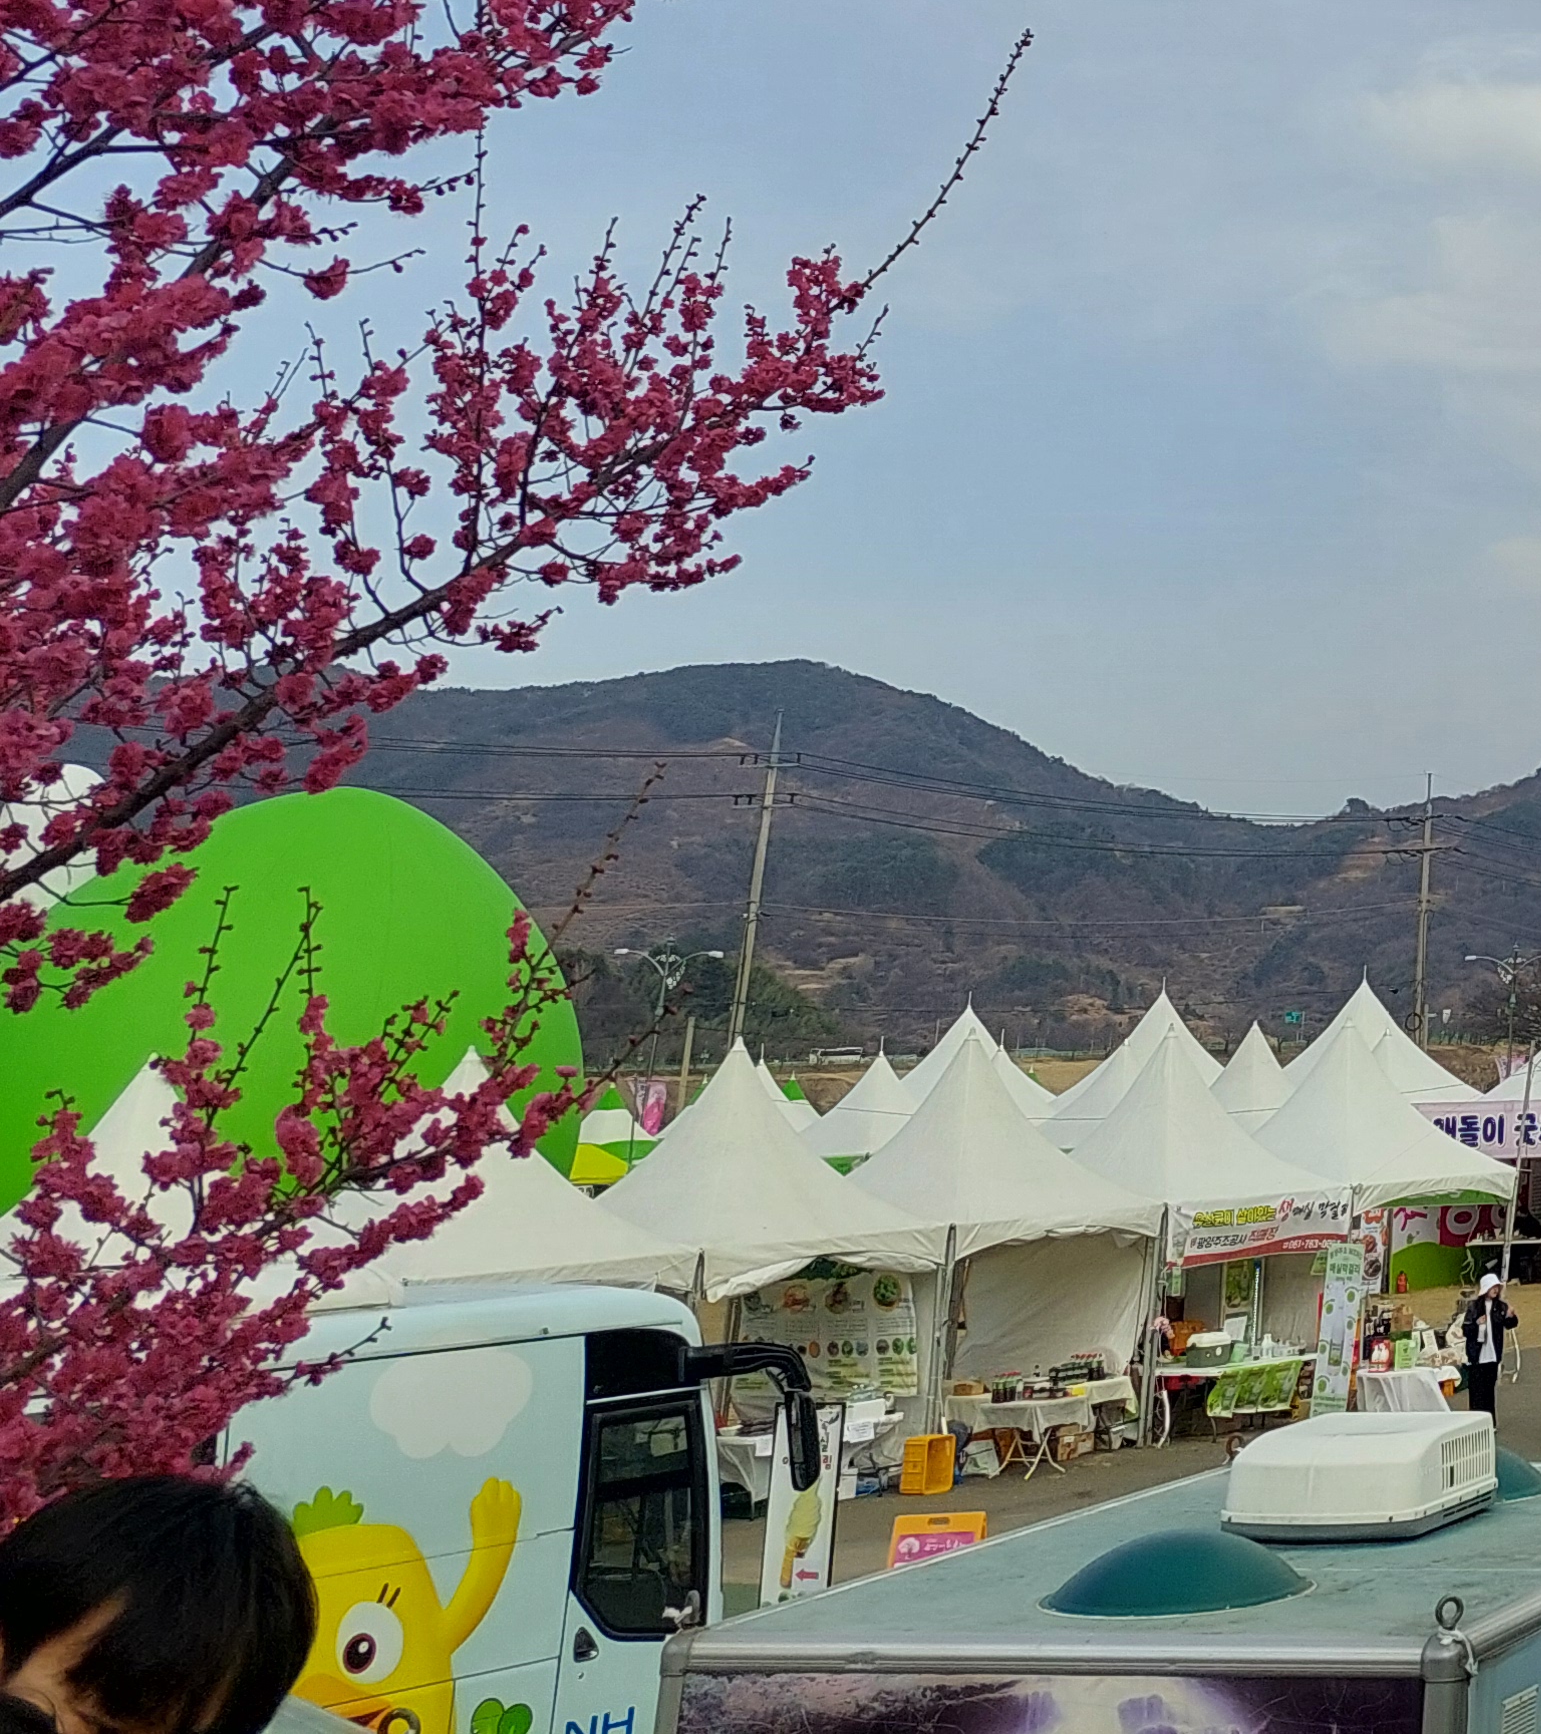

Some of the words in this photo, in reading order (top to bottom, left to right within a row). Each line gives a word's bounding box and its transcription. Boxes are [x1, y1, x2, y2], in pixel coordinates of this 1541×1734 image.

[1193, 1209, 1235, 1229] 유산균이
[1236, 1205, 1277, 1225] 살아있는
[1197, 1234, 1247, 1250] 광양주조공사
